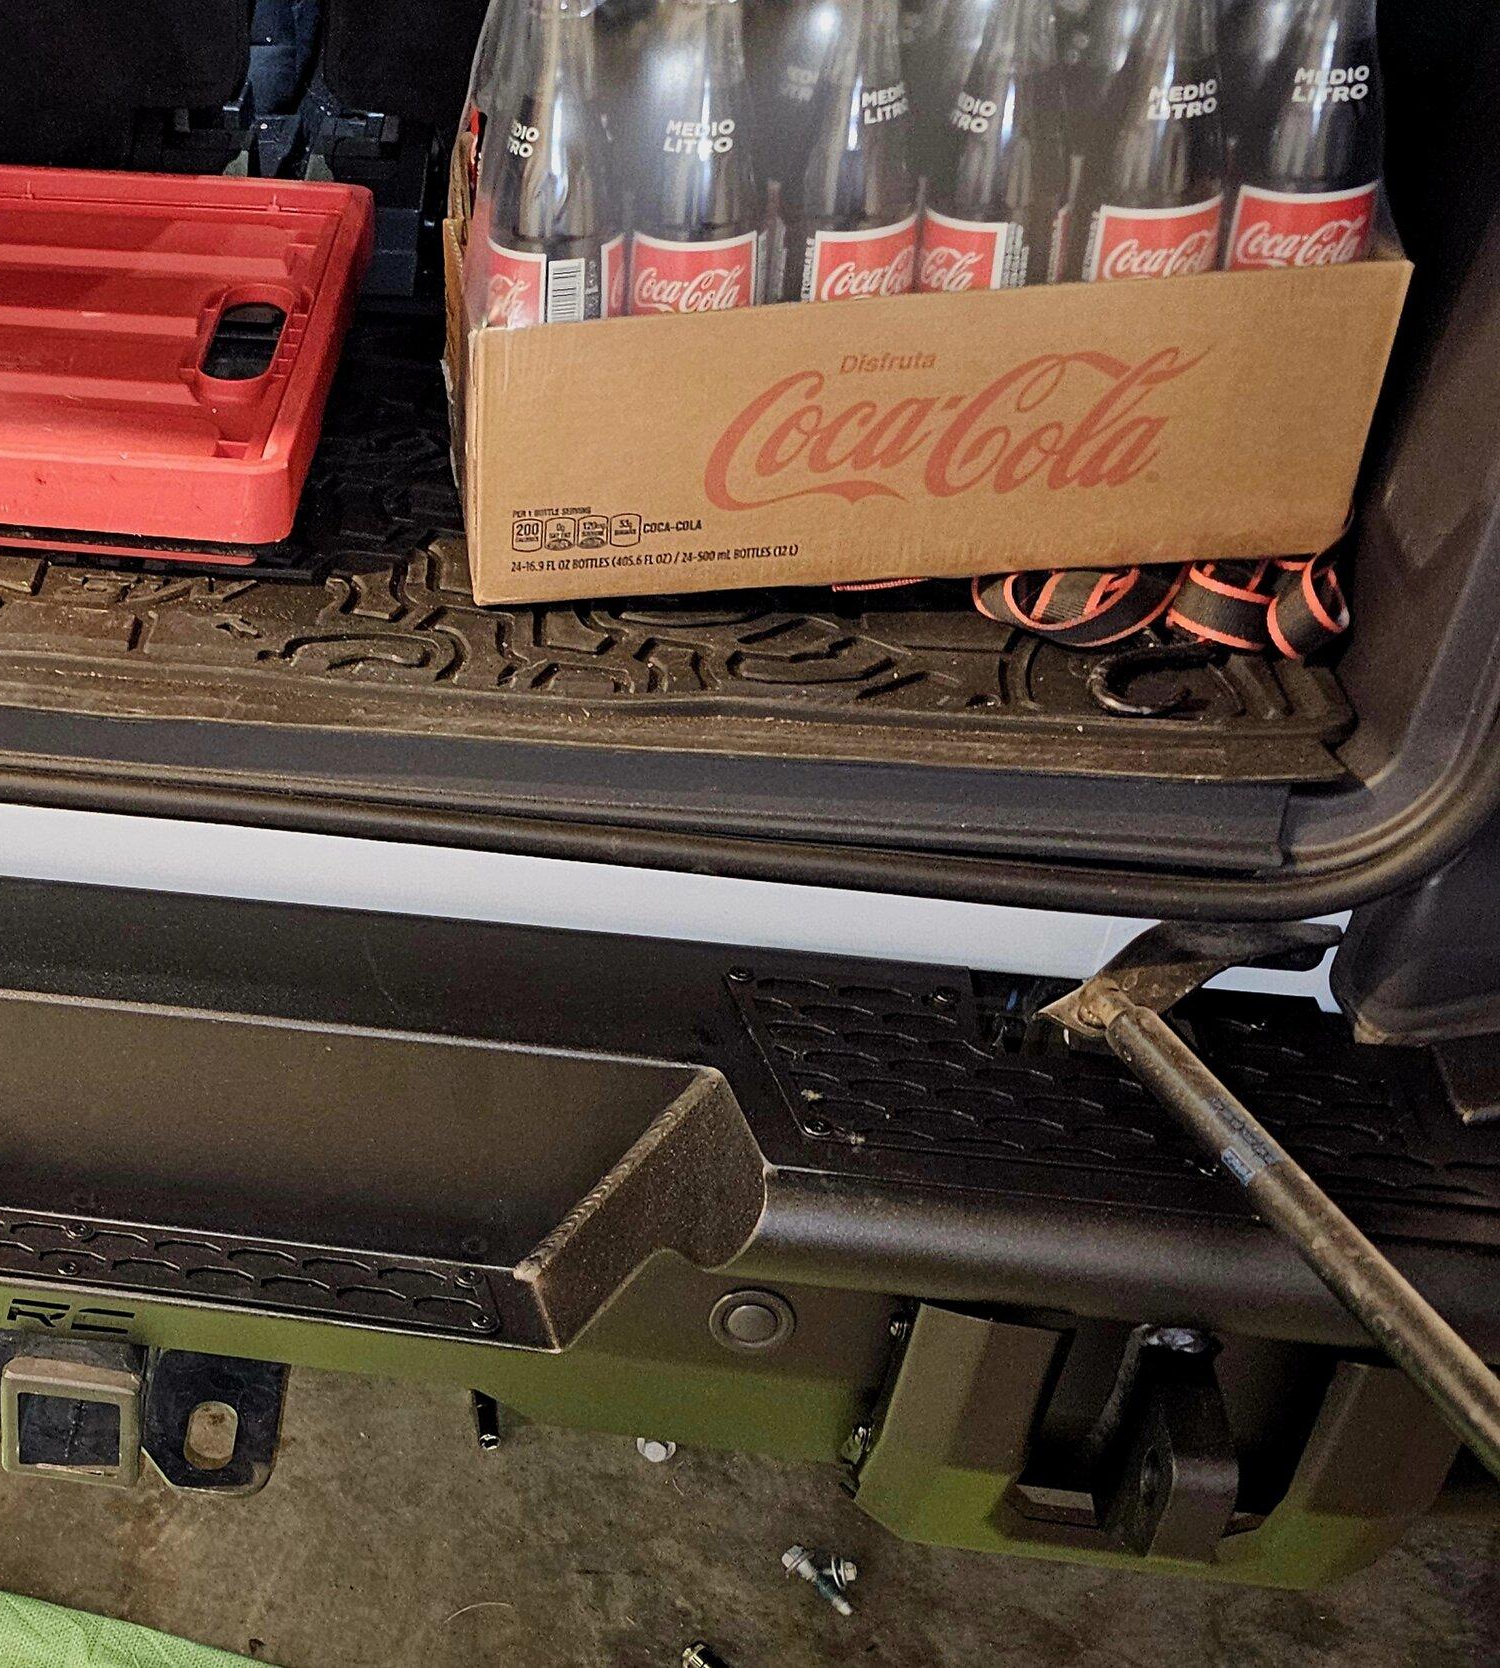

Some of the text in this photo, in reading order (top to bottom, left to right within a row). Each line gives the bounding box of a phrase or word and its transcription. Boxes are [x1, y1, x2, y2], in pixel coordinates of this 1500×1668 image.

[1294, 65, 1370, 85] MEDIO
[1148, 79, 1218, 103] MEDIO
[957, 91, 998, 118] DIO
[665, 118, 736, 137] MEDIO
[663, 136, 734, 157] LITO
[634, 264, 746, 314] Coca-Cola
[838, 352, 937, 375] Disfruta
[704, 347, 1212, 511] Coca-Cola
[516, 523, 539, 537] 200
[643, 520, 702, 534] COCA-COLA
[546, 560, 556, 571] FL
[558, 559, 571, 570] OZ
[573, 557, 610, 569] BOTTLES
[644, 554, 654, 565] FL
[656, 552, 673, 564] OZ)
[734, 546, 771, 559] BOTTLES
